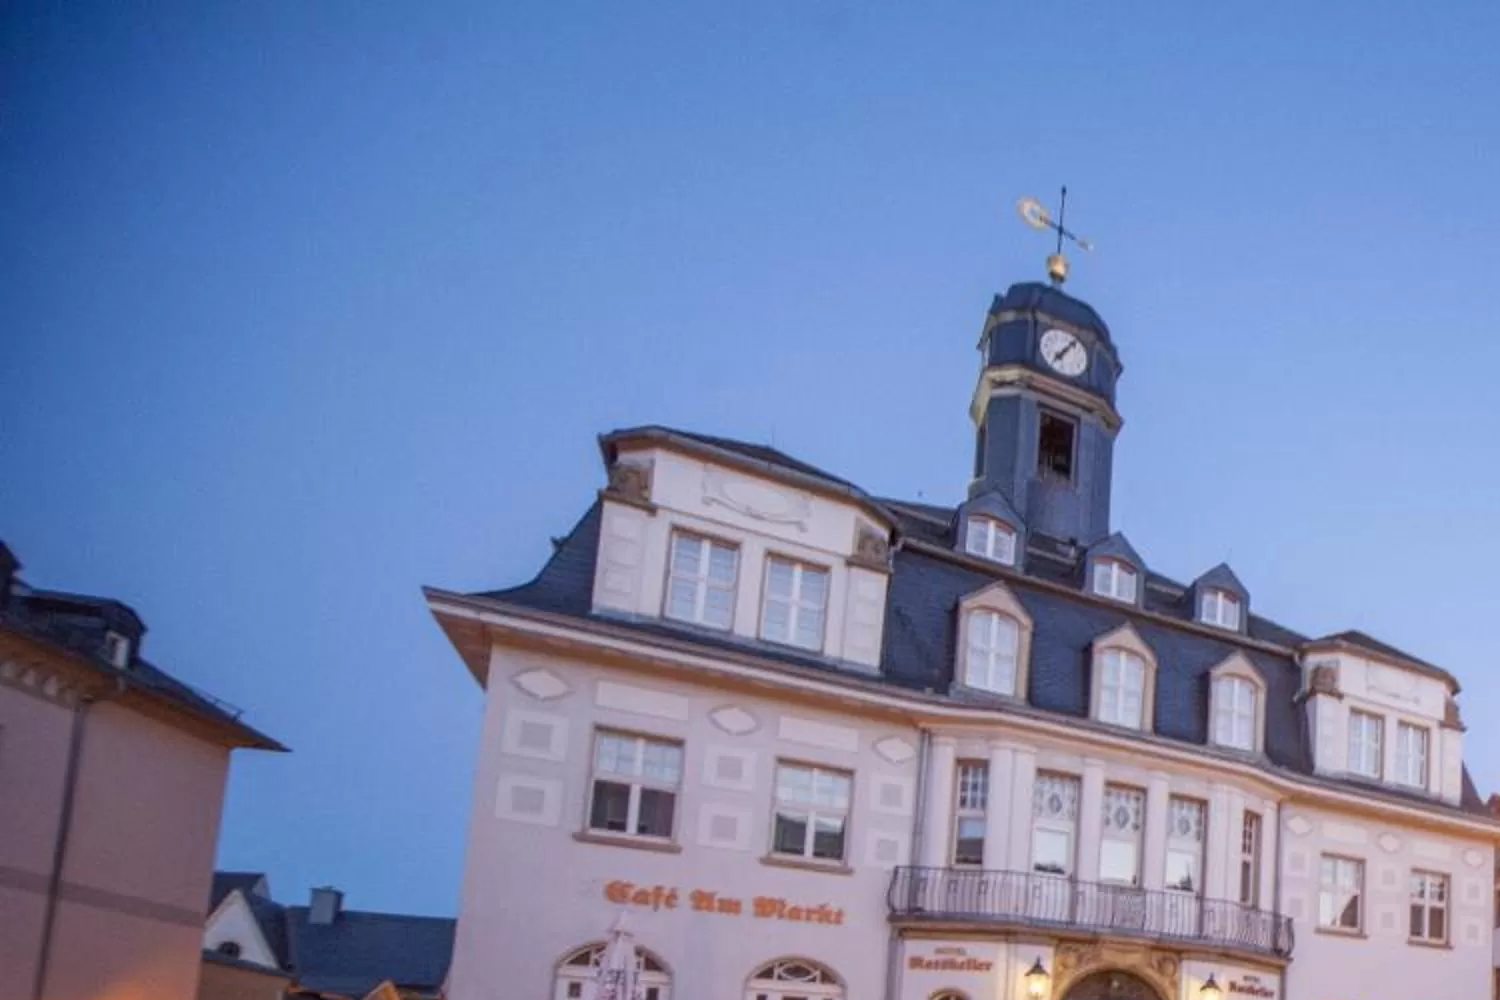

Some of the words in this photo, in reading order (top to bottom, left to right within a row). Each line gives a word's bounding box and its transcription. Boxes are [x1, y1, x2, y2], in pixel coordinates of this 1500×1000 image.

[604, 879, 679, 912] Café
[689, 888, 742, 916] Am
[752, 895, 845, 925] Markt
